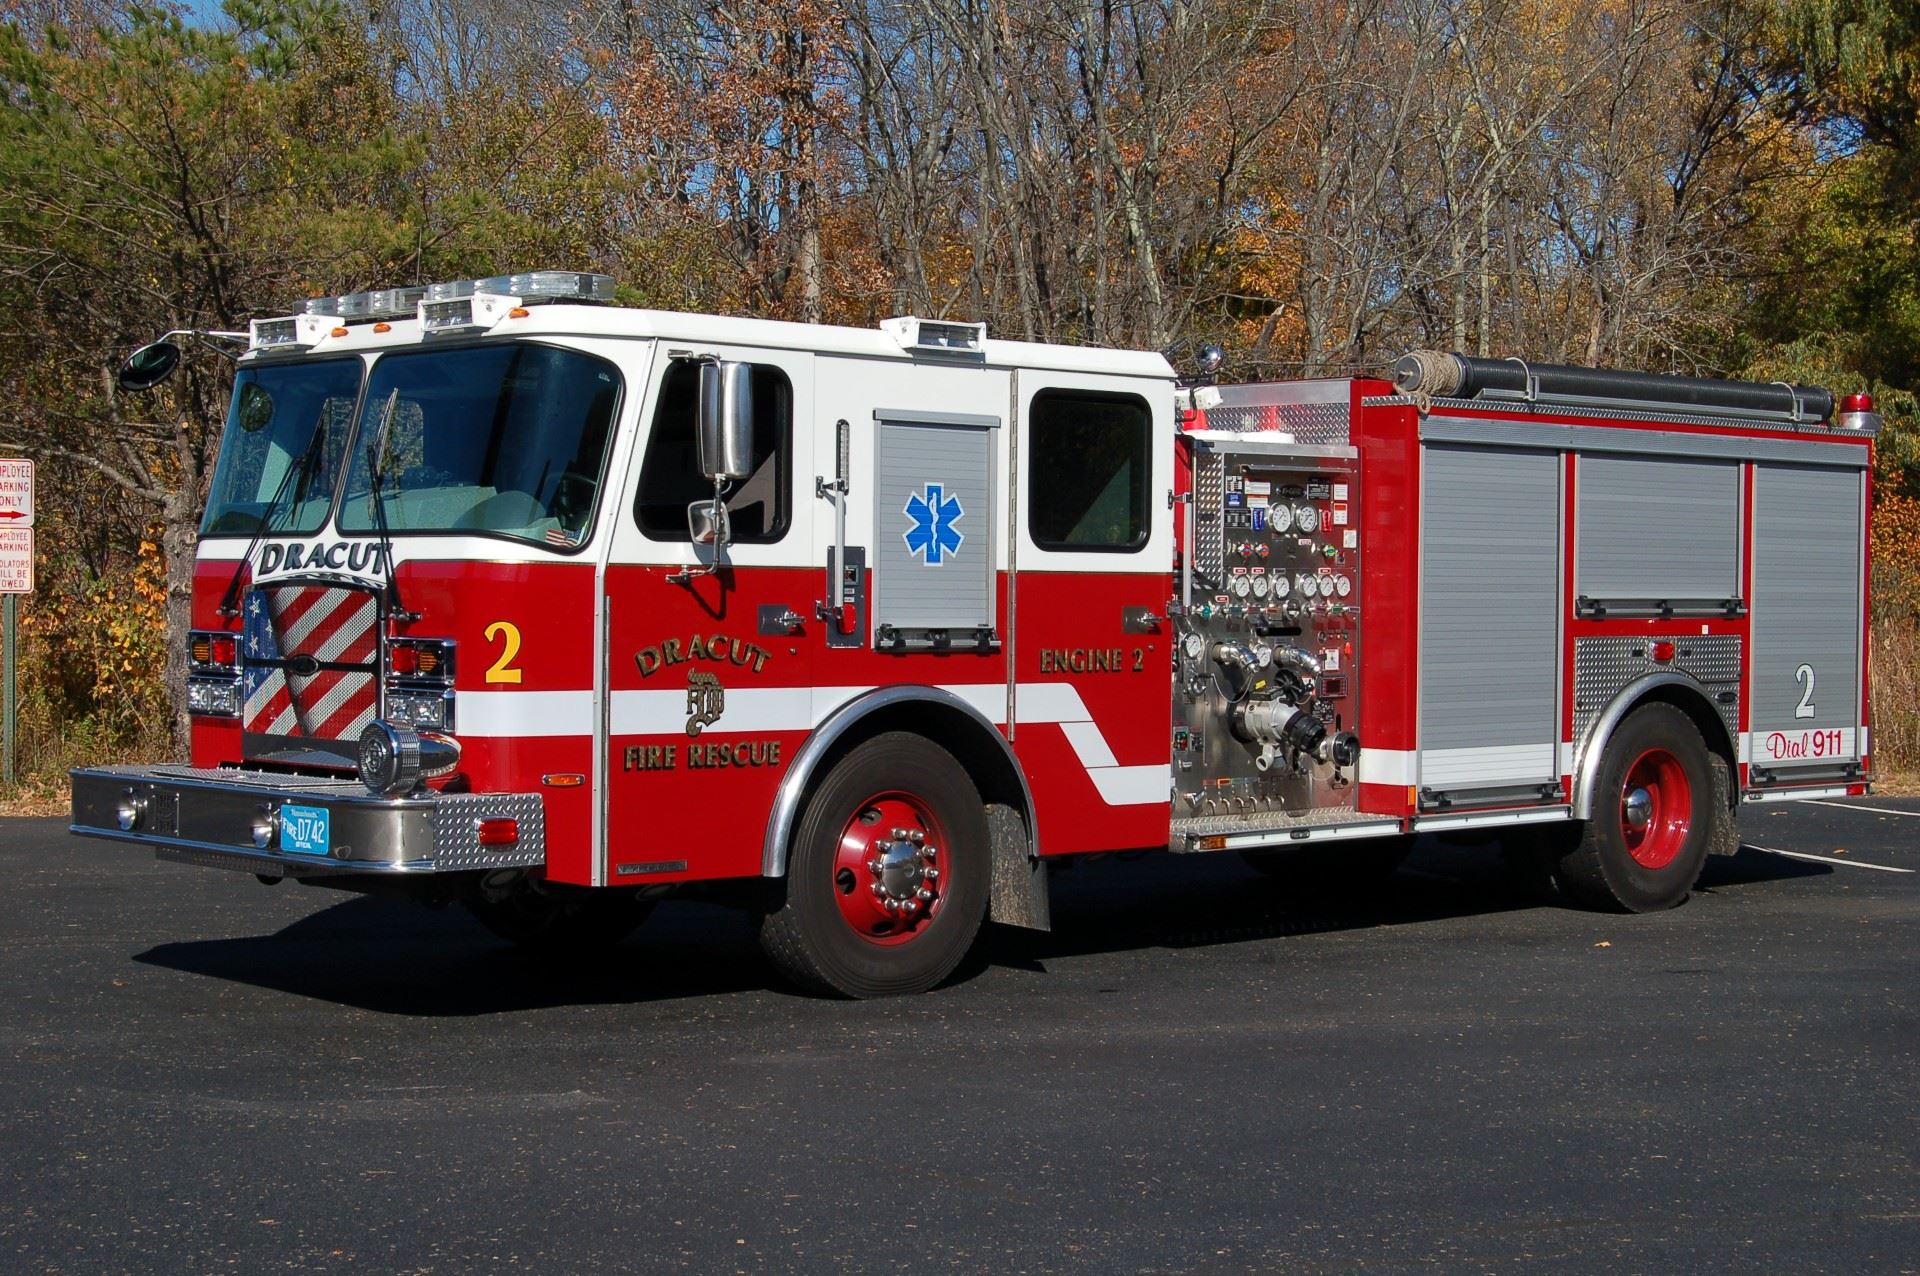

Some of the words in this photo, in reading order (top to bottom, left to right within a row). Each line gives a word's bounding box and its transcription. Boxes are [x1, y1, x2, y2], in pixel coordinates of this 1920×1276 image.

[0, 465, 31, 478] PLOYEE
[0, 481, 30, 493] ARKING
[0, 543, 29, 552] ARKING
[258, 542, 394, 576] DRACUT
[0, 559, 30, 569] OLATORS
[0, 569, 13, 579] ILL
[16, 569, 28, 579] BE
[0, 579, 25, 589] OWED
[484, 621, 522, 684] 2
[634, 634, 773, 678] DRACUT
[1040, 648, 1122, 674] ENGINE
[1132, 648, 1144, 672] 2
[1794, 663, 1816, 720] 2
[624, 744, 676, 771] FIRE
[687, 740, 781, 770] RESCUE
[1766, 731, 1808, 759] Dial
[1812, 730, 1842, 757] 911
[297, 818, 325, 844] D742
